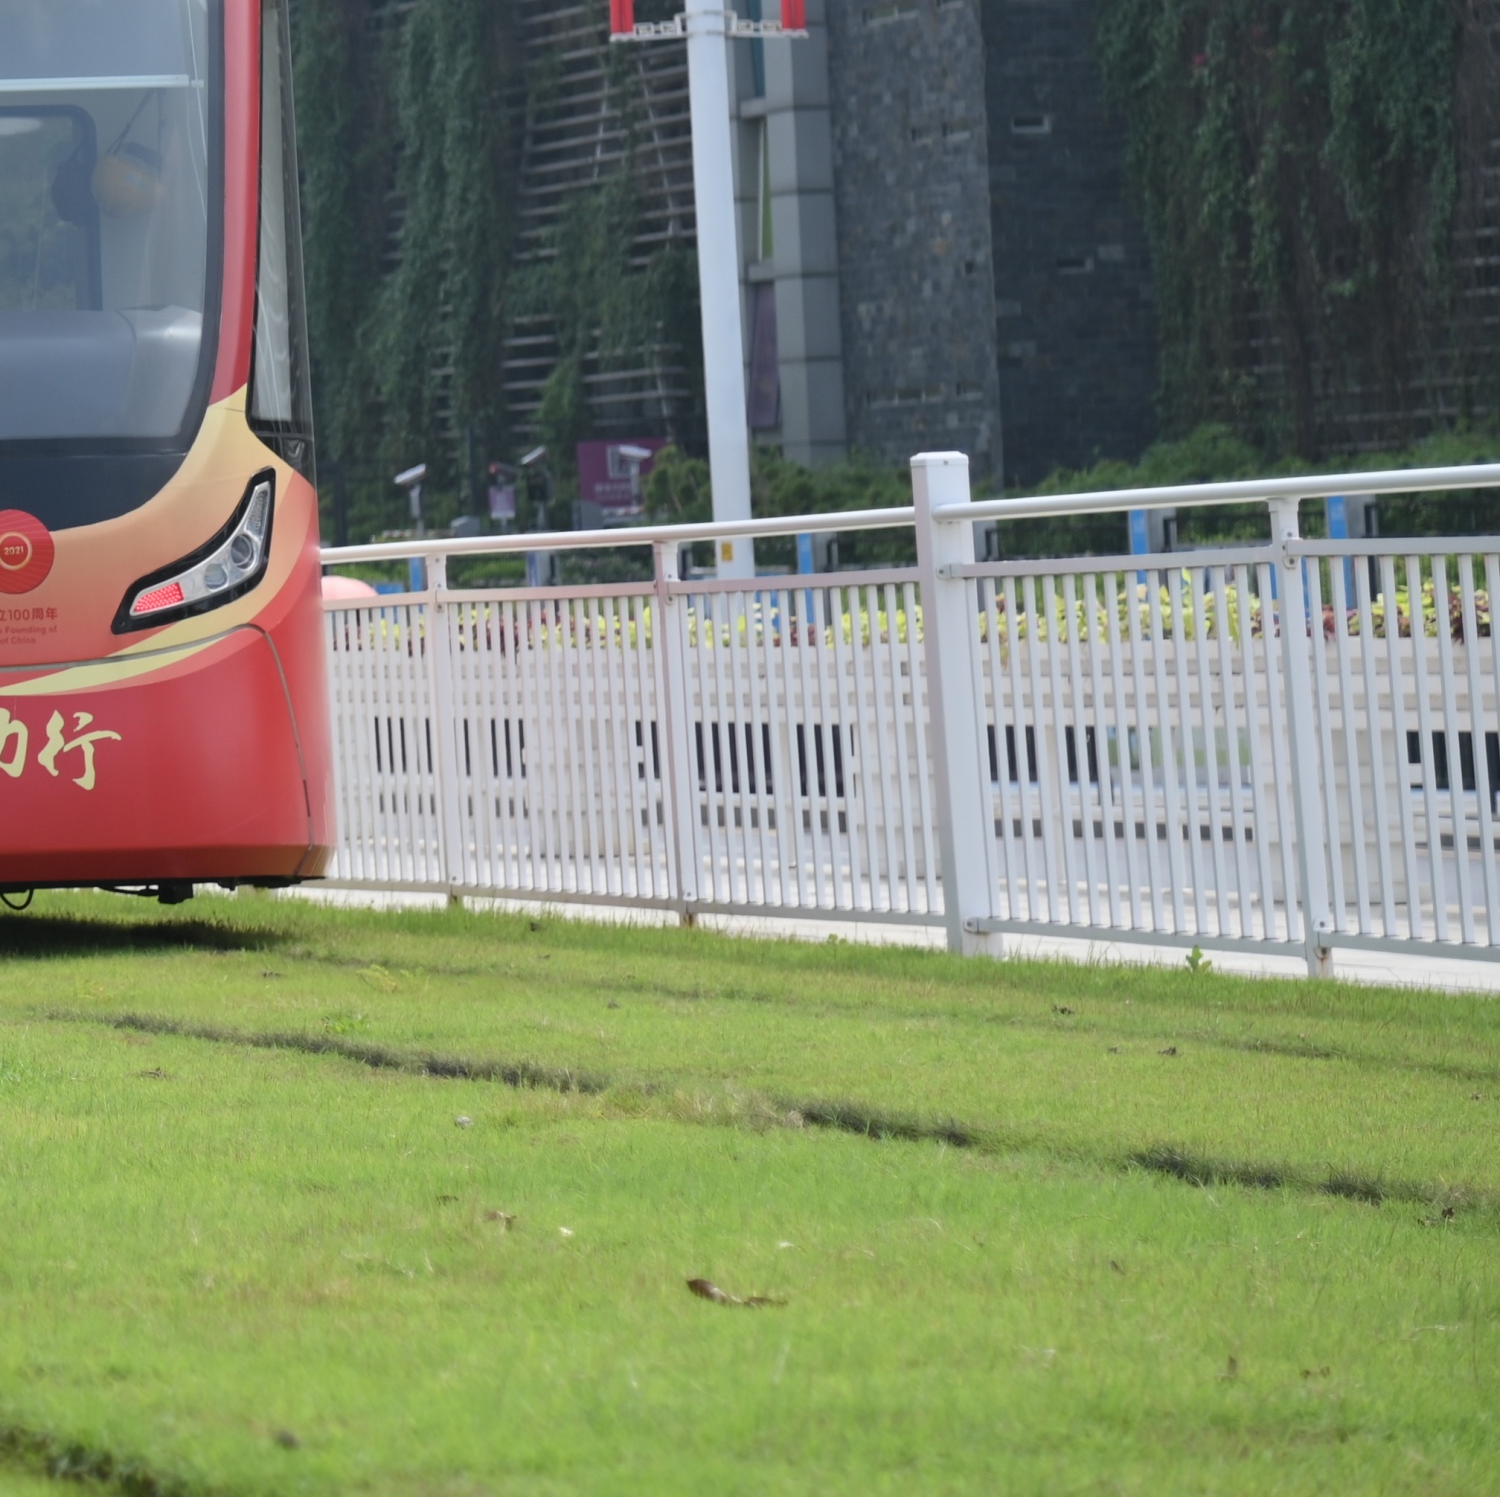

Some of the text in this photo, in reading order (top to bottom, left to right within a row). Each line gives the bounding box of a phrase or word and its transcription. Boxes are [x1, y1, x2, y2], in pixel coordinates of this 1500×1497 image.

[3, 545, 25, 555] 2021
[5, 625, 46, 636] Founding
[49, 624, 58, 634] of
[0, 637, 9, 646] of
[10, 636, 37, 646] China
